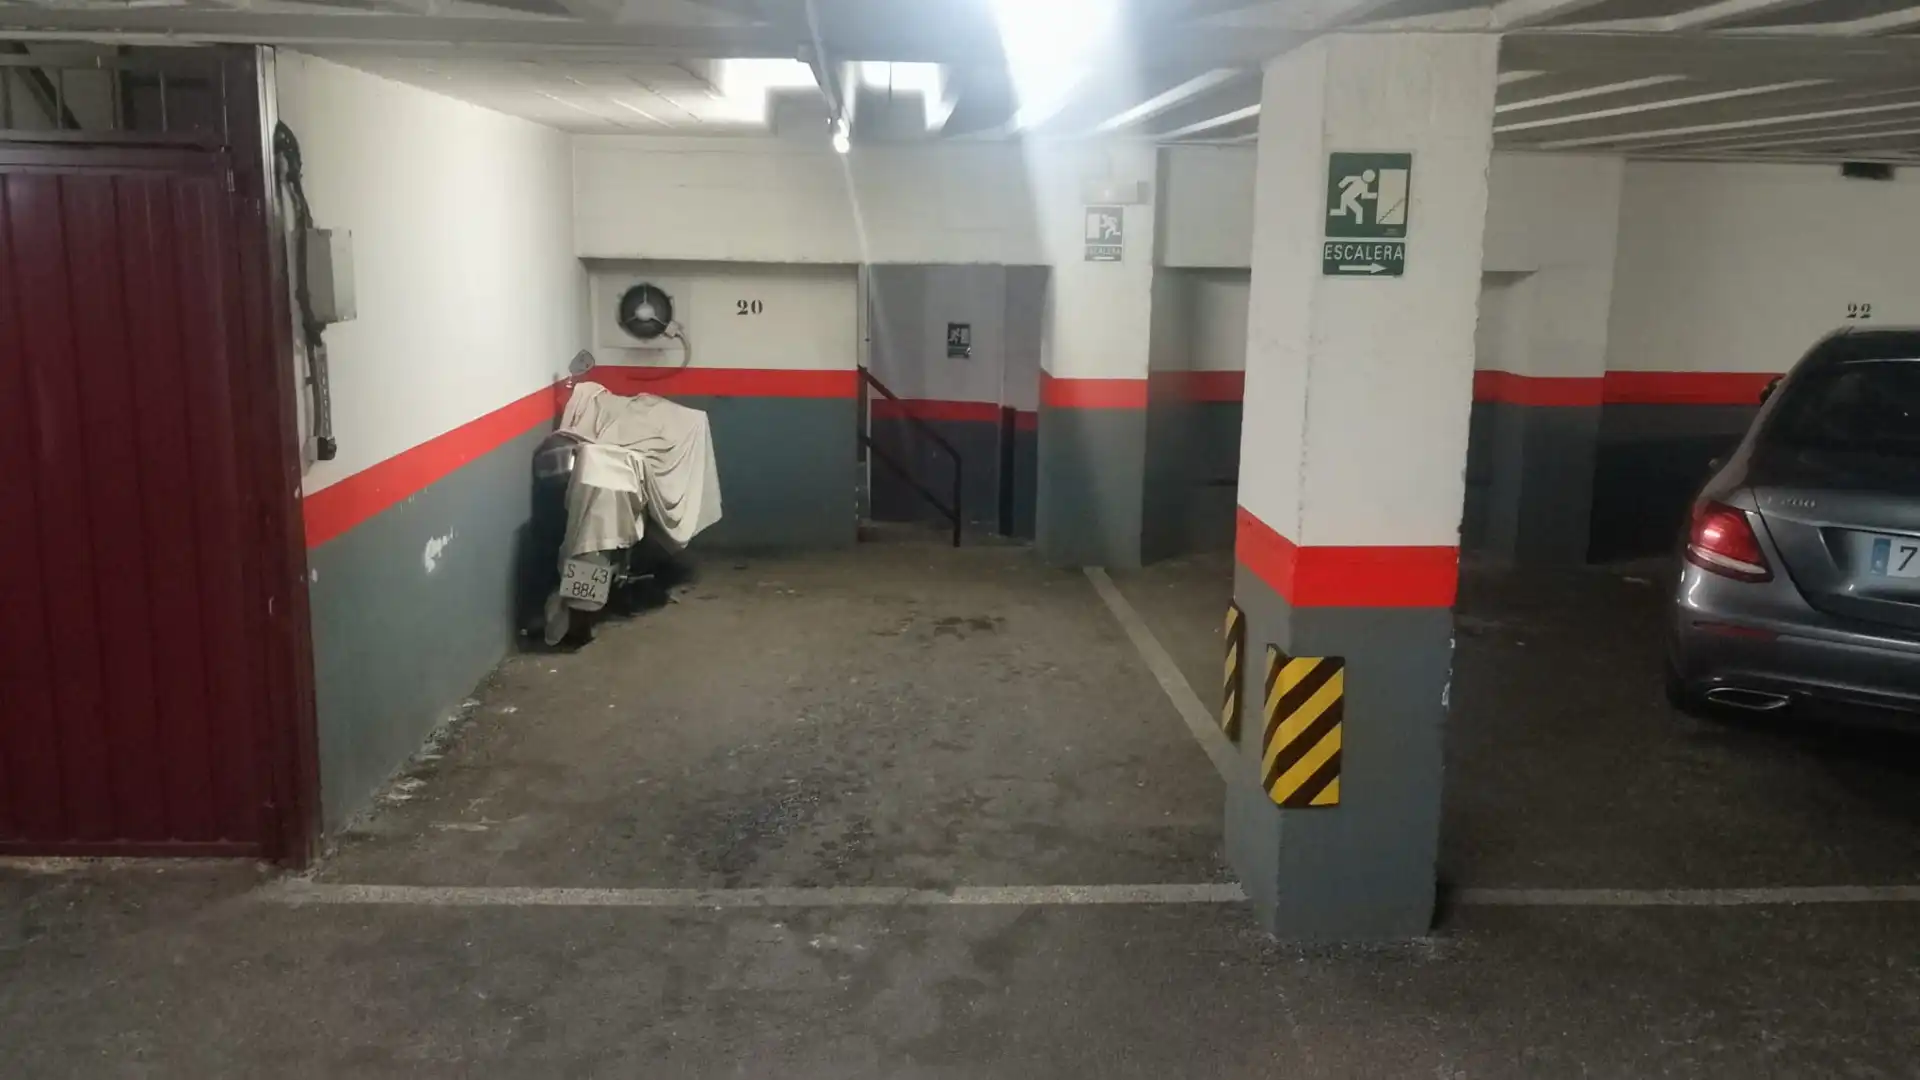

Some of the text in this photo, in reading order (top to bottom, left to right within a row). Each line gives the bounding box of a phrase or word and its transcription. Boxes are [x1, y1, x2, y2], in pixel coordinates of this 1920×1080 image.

[1324, 244, 1403, 260] ESCALERA
[736, 299, 763, 315] 20
[1847, 303, 1871, 319] 22
[1898, 545, 1918, 571] 7
[591, 568, 609, 584] 43
[572, 581, 596, 600] 884
